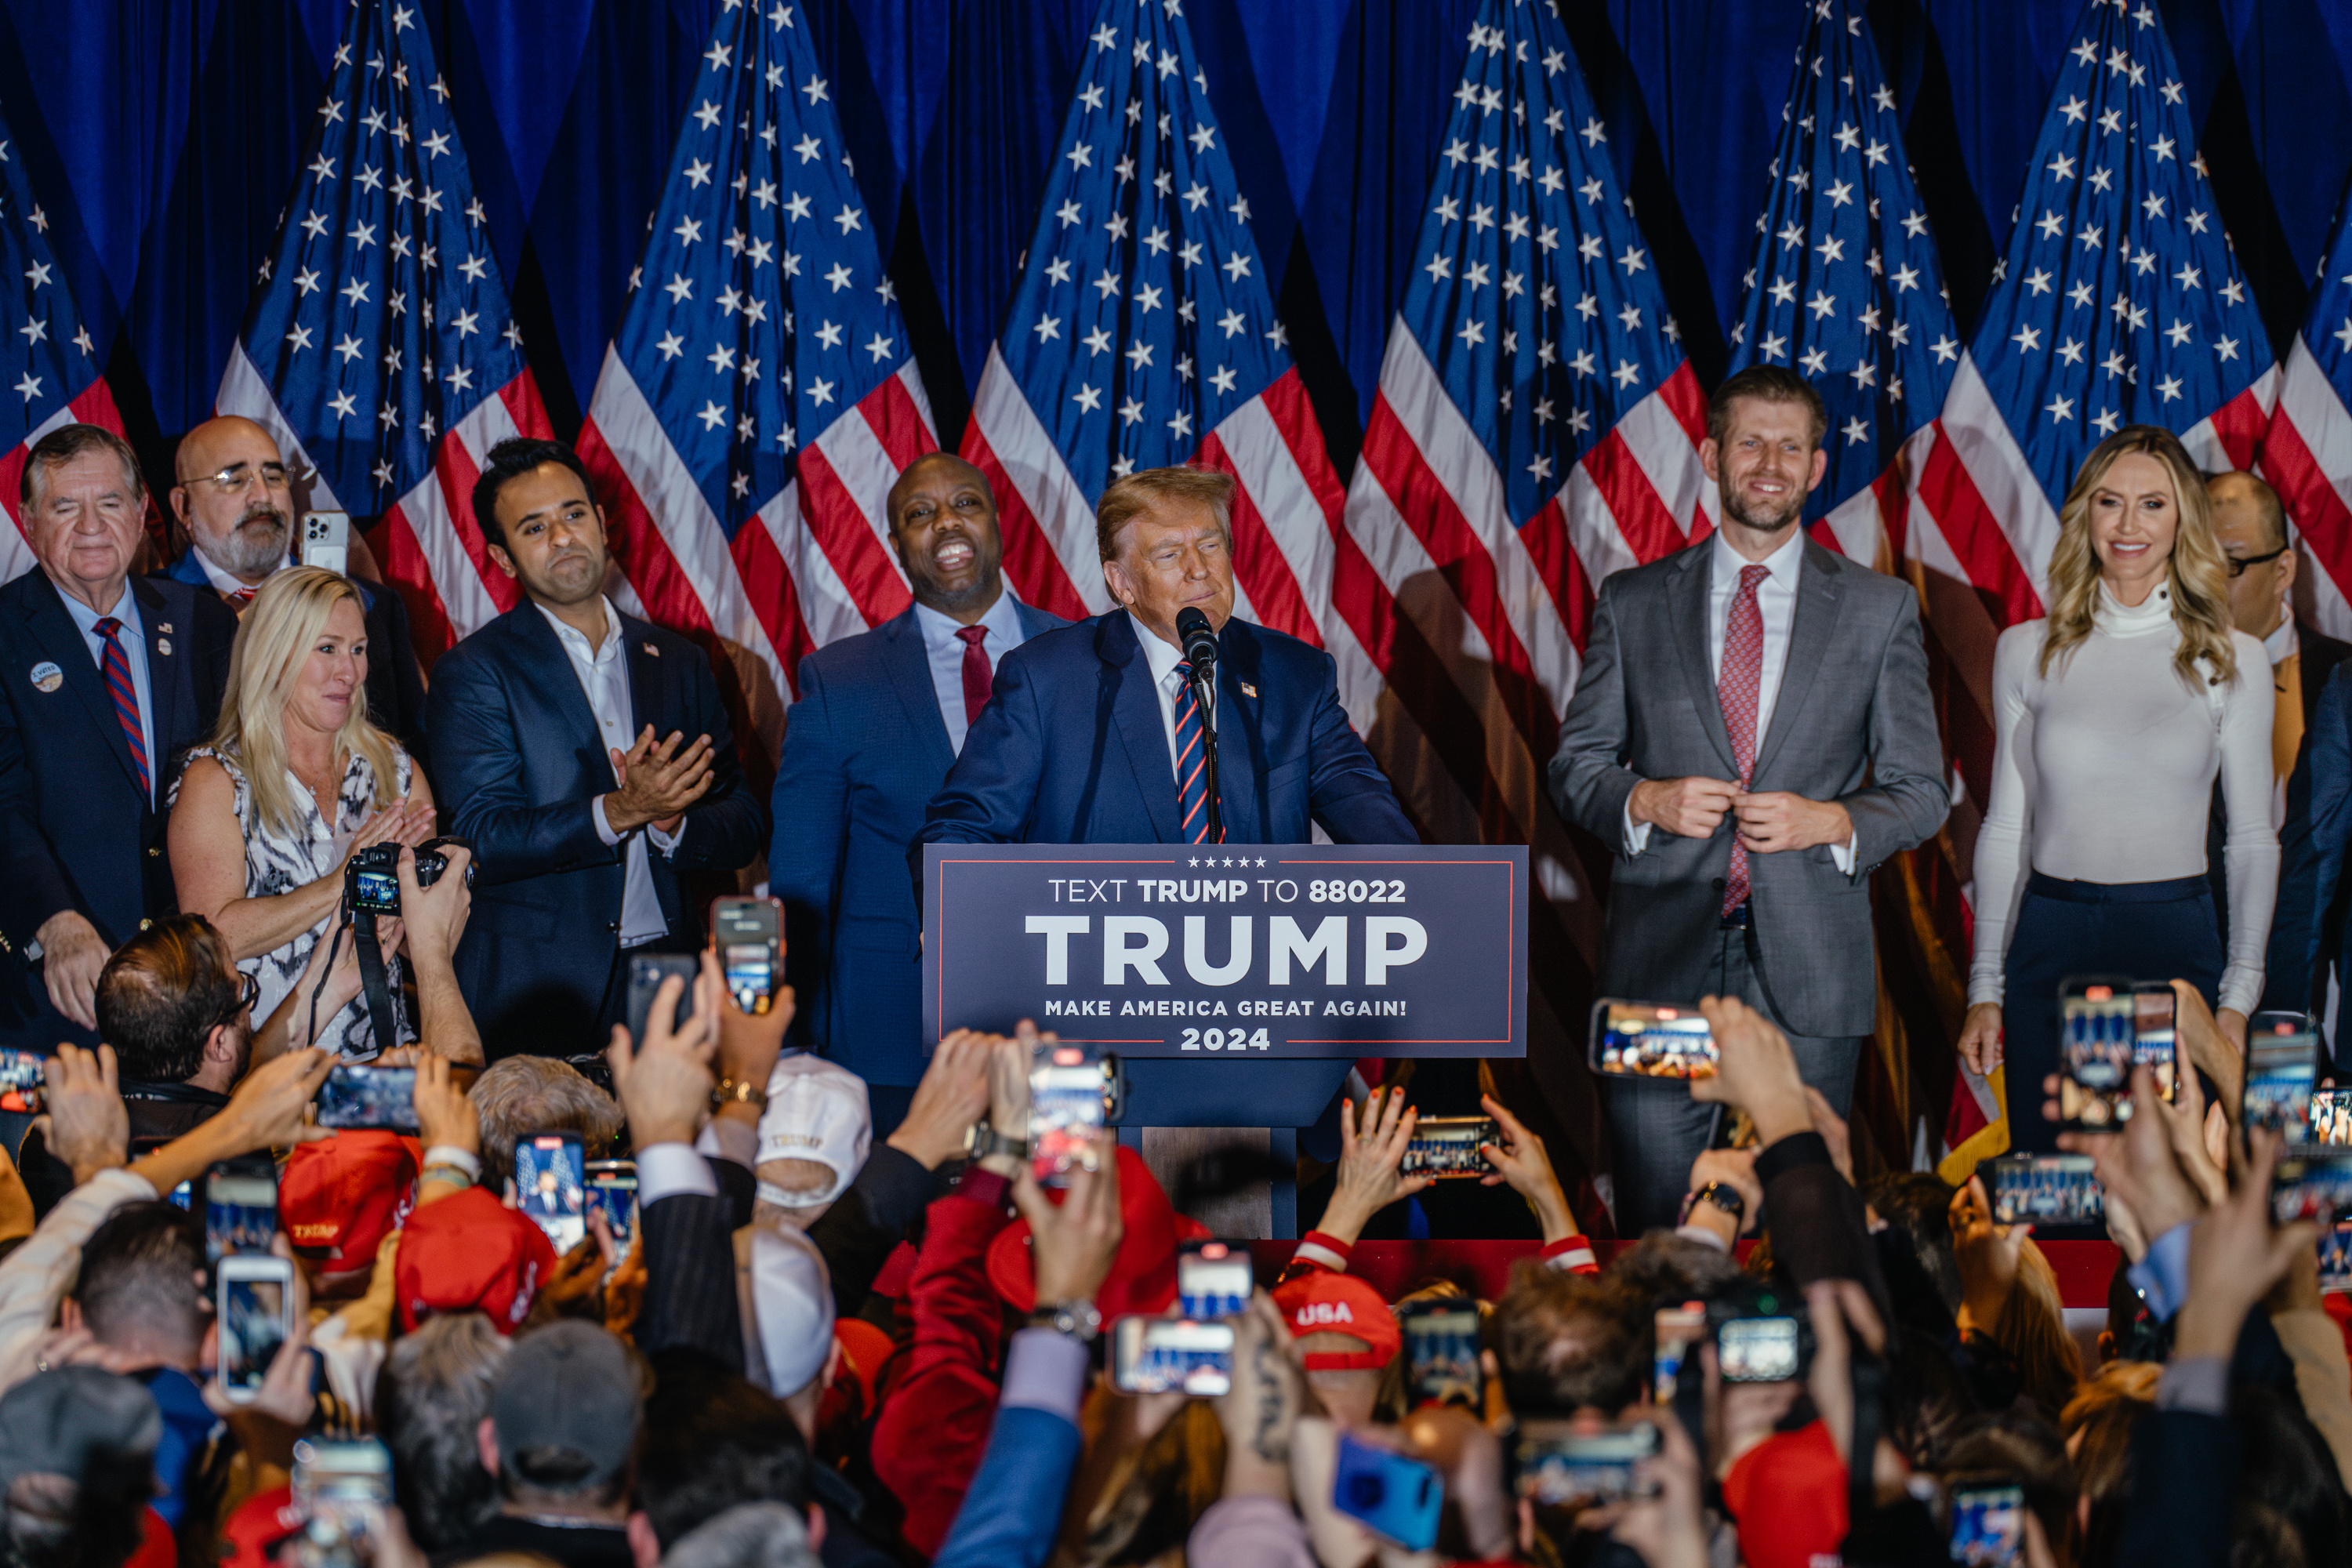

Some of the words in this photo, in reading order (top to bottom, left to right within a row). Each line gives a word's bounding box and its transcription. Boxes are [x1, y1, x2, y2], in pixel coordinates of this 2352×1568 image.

[1048, 879, 1128, 902] TEXT
[1137, 879, 1248, 903] TRUMP
[1258, 879, 1298, 903] TO
[1308, 879, 1406, 903] 88022
[1025, 915, 1428, 986] TRUMP
[1045, 1000, 1111, 1016] MAKE
[1120, 1000, 1229, 1017] AMERICA
[1237, 1000, 1315, 1017] GREAT
[1323, 1000, 1407, 1017] AGAIN!
[1181, 1027, 1271, 1051] 2024
[772, 1135, 822, 1150] TRUMP
[1296, 1301, 1354, 1327] USA
